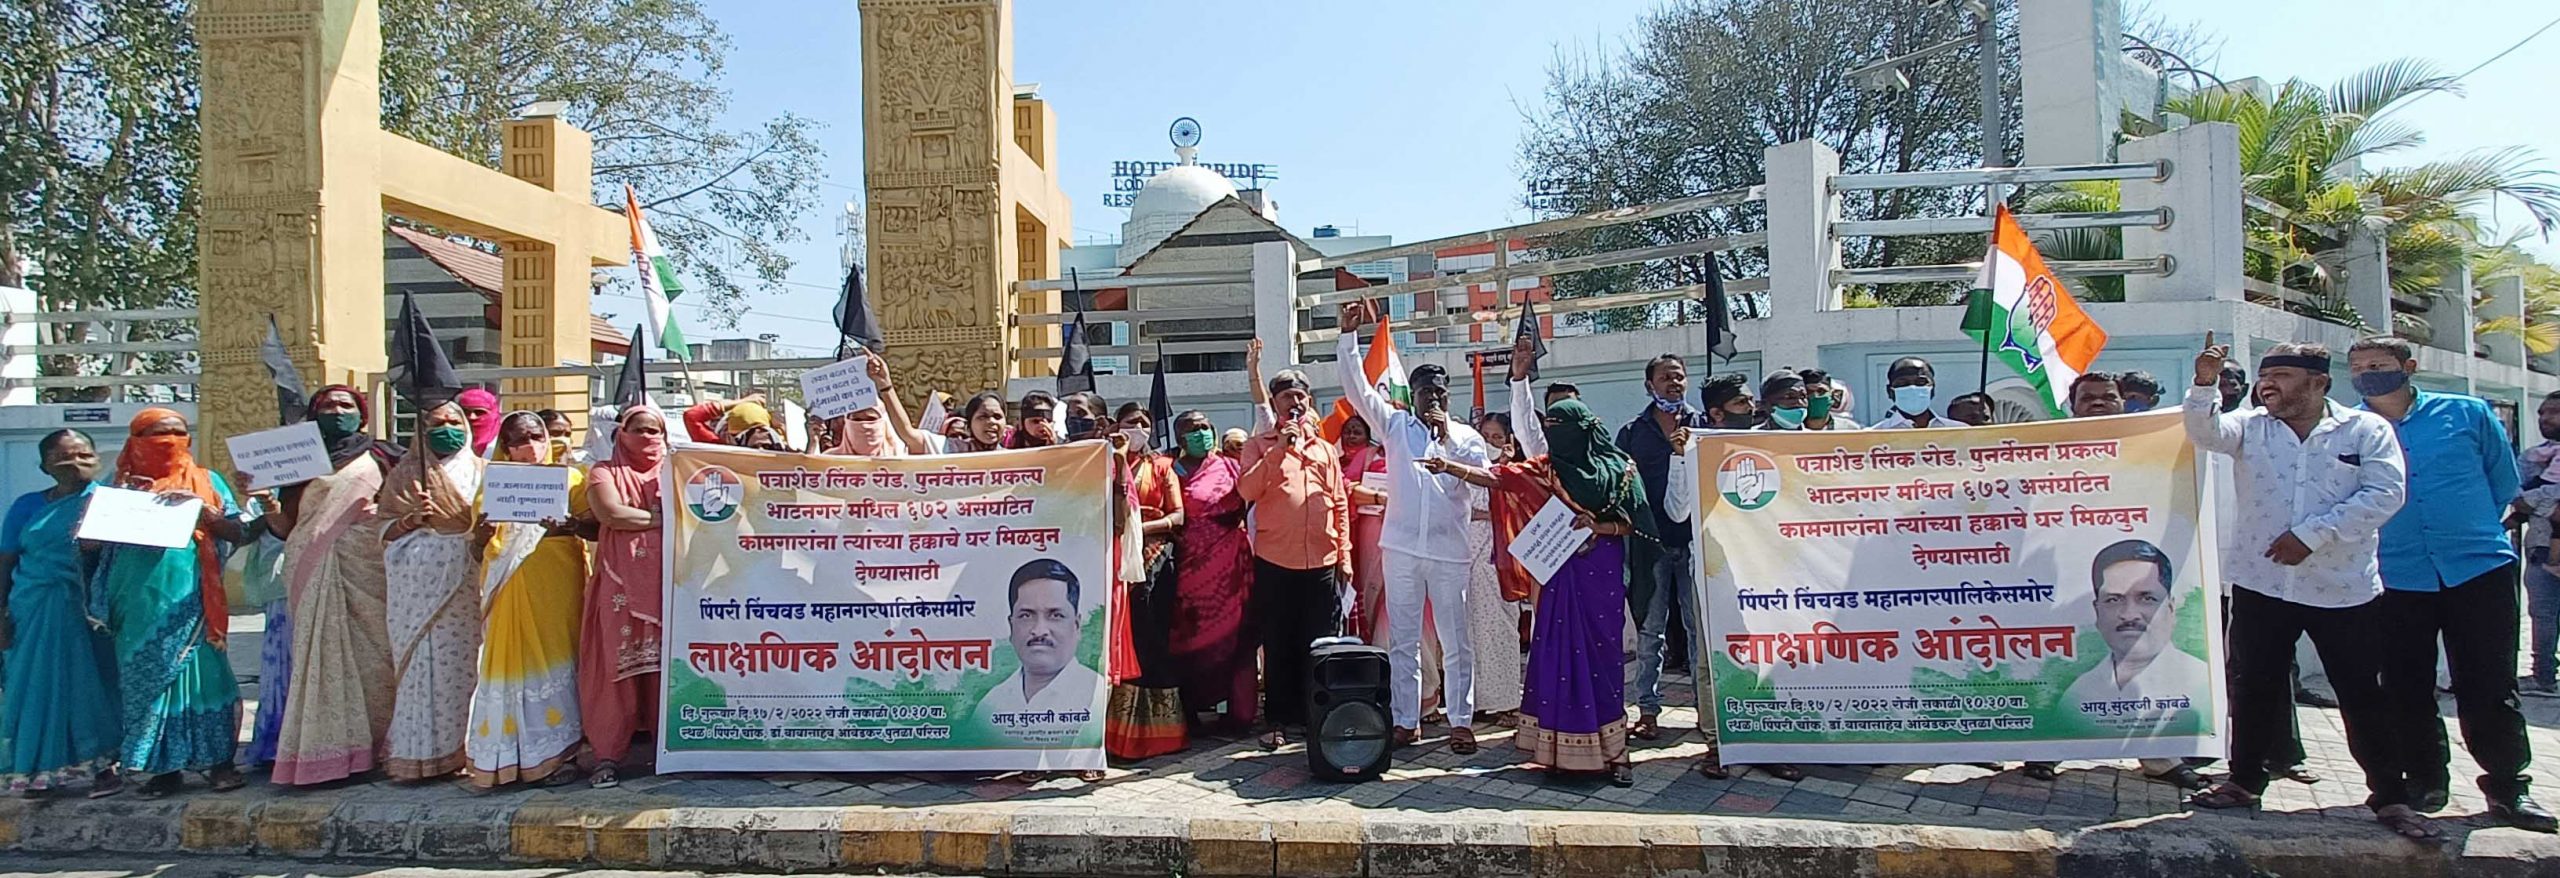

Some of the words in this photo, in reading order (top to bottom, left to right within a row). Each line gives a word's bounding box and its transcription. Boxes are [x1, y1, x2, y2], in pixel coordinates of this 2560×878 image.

[1113, 161, 1183, 177] HOTE
[1114, 178, 1144, 191] LOD
[1103, 194, 1134, 207] RES
[1796, 449, 1865, 472] पत्राशेड
[1870, 446, 1916, 470] लिंक
[1969, 440, 2050, 472] पुनर्वेसन
[2055, 441, 2118, 460] प्रकल्प
[759, 467, 822, 489] पत्राशेड
[826, 468, 867, 488] लिंक
[915, 466, 986, 495] पुनर्वेसन
[990, 468, 1044, 486] प्रकल्प
[1807, 486, 1891, 505] भाटनगर
[1896, 479, 1954, 501] मधिल
[1963, 478, 2011, 501] ६७२
[2018, 471, 2111, 495] असंघटित
[766, 502, 843, 520] भाटनगर
[847, 498, 900, 519] मधिल
[907, 500, 948, 521] ६७२
[956, 495, 1035, 517] असंघटित
[1778, 513, 1889, 539] कामगारांना
[1893, 510, 1962, 534] त्यांच्या
[1967, 506, 2028, 536] हक्काचे
[2034, 511, 2064, 528] घर
[2070, 504, 2149, 533] मिळवुन
[738, 529, 838, 551] कामगारांना
[843, 528, 904, 551] त्यांच्या
[909, 527, 961, 554] हक्काचे
[965, 531, 991, 547] घर
[996, 525, 1061, 552] मिळवुन
[1912, 541, 2011, 570] देण्यासाठी
[855, 559, 940, 586] देण्यासाठी
[700, 598, 740, 620] पिंपरी
[746, 597, 806, 620] चिंचवड
[811, 594, 976, 623] महानगरपालिकेसमोर
[1738, 587, 1788, 611] पिंपरी
[1794, 586, 1859, 610] चिंचवड
[1863, 579, 2055, 612] महानगरपालिकेसमोर
[688, 630, 839, 677] लाक्षणिक
[850, 628, 992, 678] आंदोलन
[1726, 621, 1899, 669] लाक्षणिक
[1912, 615, 2076, 668] आंदोलन
